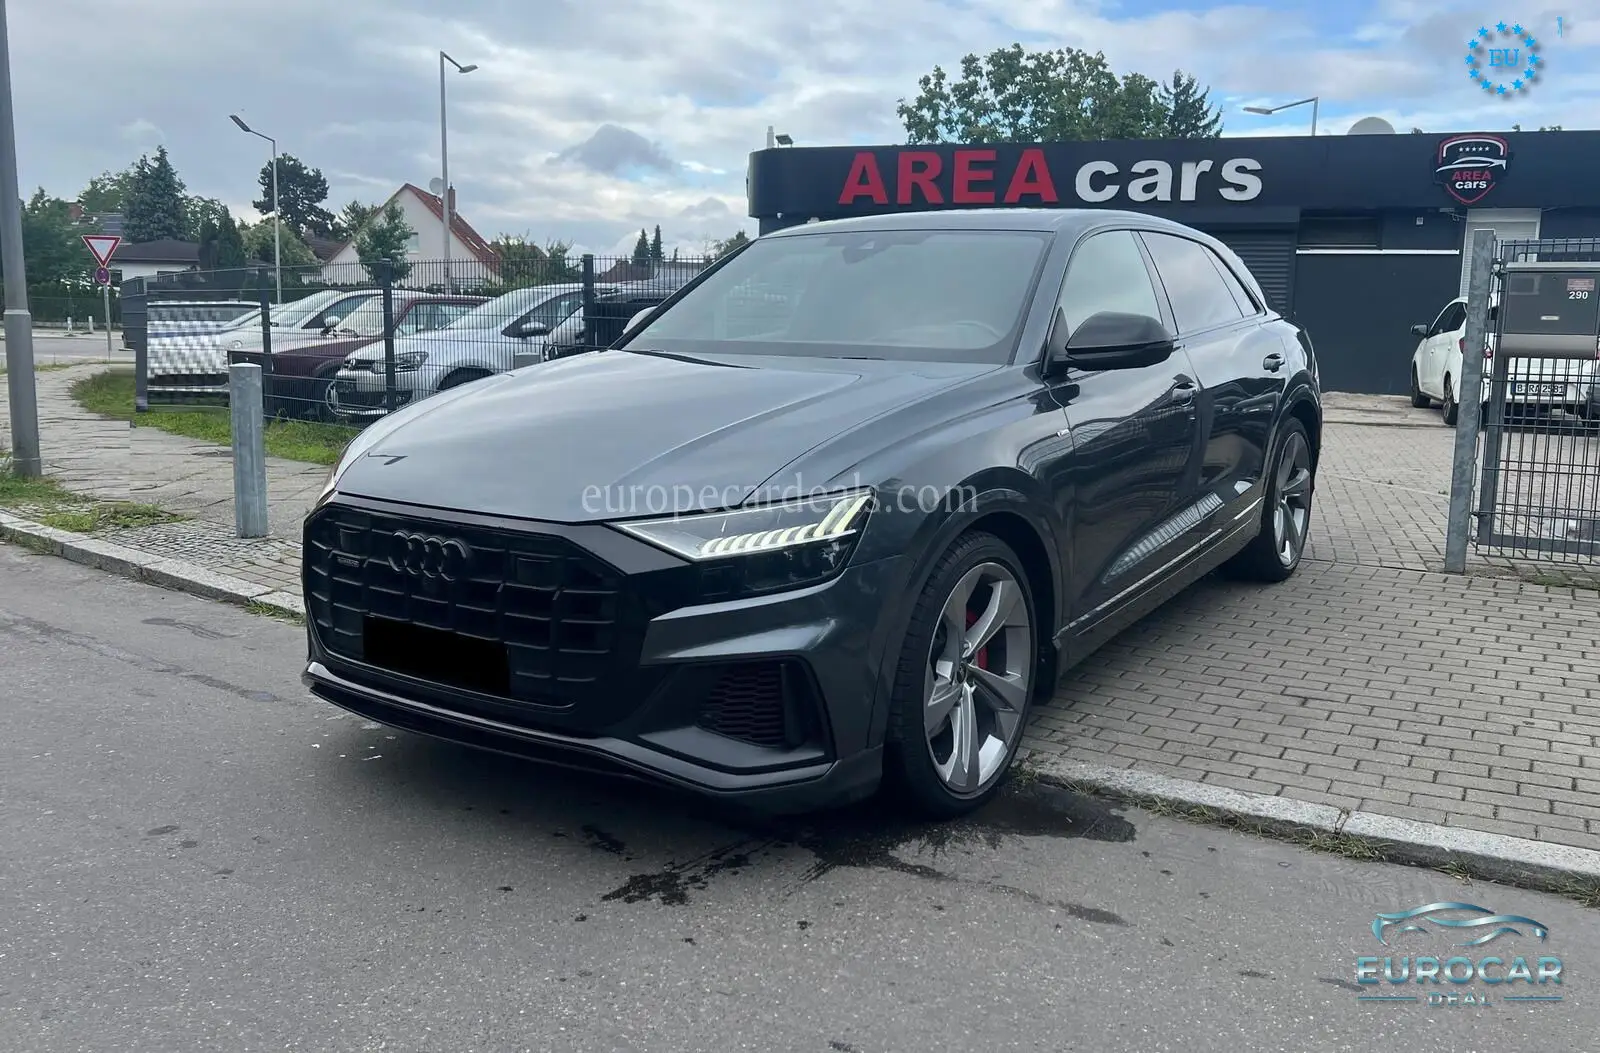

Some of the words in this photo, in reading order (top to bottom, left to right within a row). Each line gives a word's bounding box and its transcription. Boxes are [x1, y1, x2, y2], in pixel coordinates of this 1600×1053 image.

[838, 149, 1059, 205] AREA
[1075, 157, 1263, 202] cars
[1452, 170, 1492, 181] AREA
[1455, 180, 1487, 189] cars
[1569, 291, 1588, 300] 290
